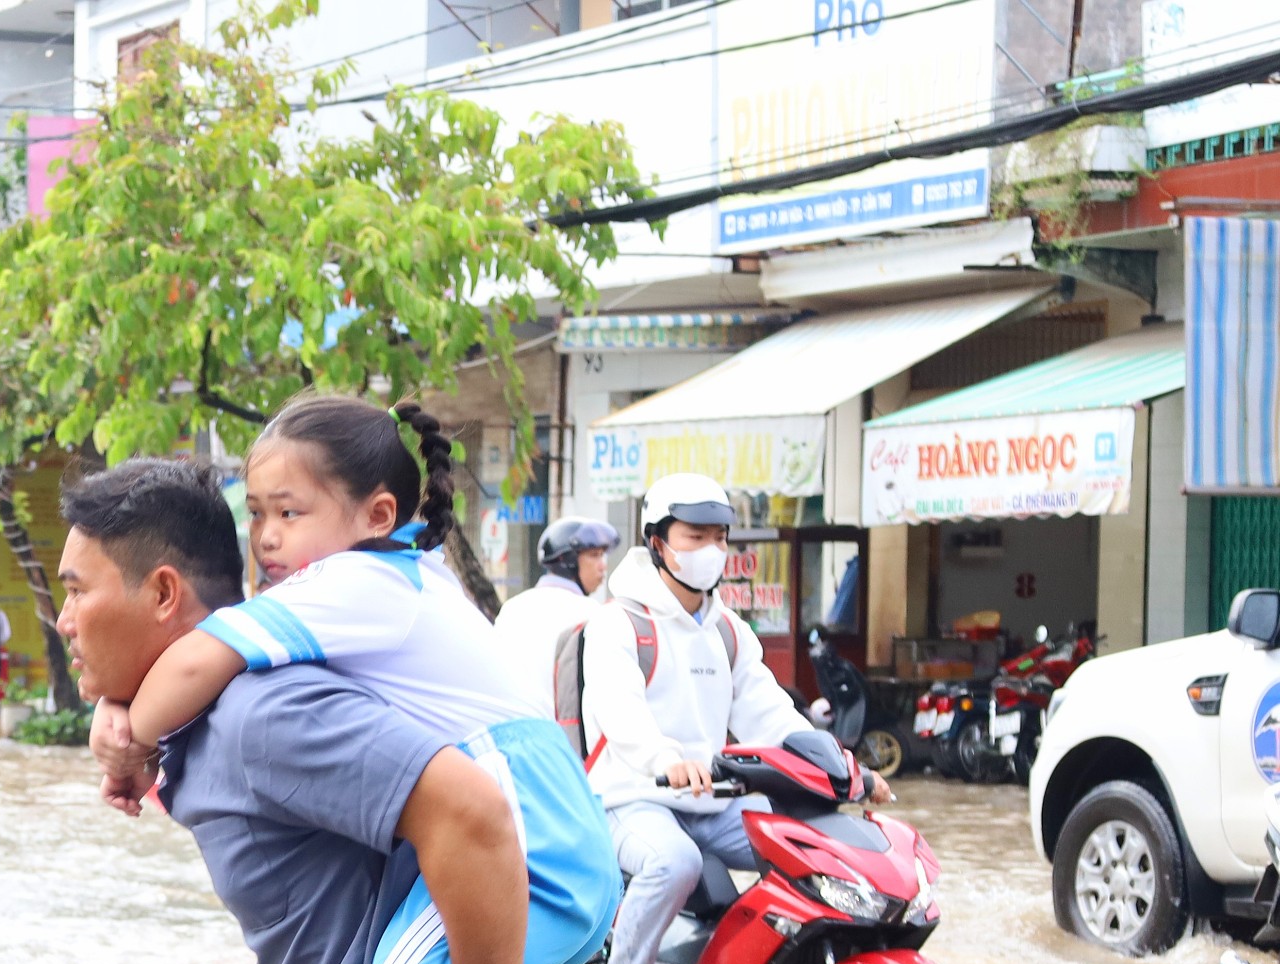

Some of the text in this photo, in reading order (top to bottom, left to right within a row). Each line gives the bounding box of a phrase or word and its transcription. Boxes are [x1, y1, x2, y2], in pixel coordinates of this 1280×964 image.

[591, 430, 641, 469] Phở
[731, 432, 773, 488] MAI
[916, 431, 1000, 480] HOÀNG
[1006, 432, 1077, 483] NGỌC
[753, 583, 783, 609] MAI
